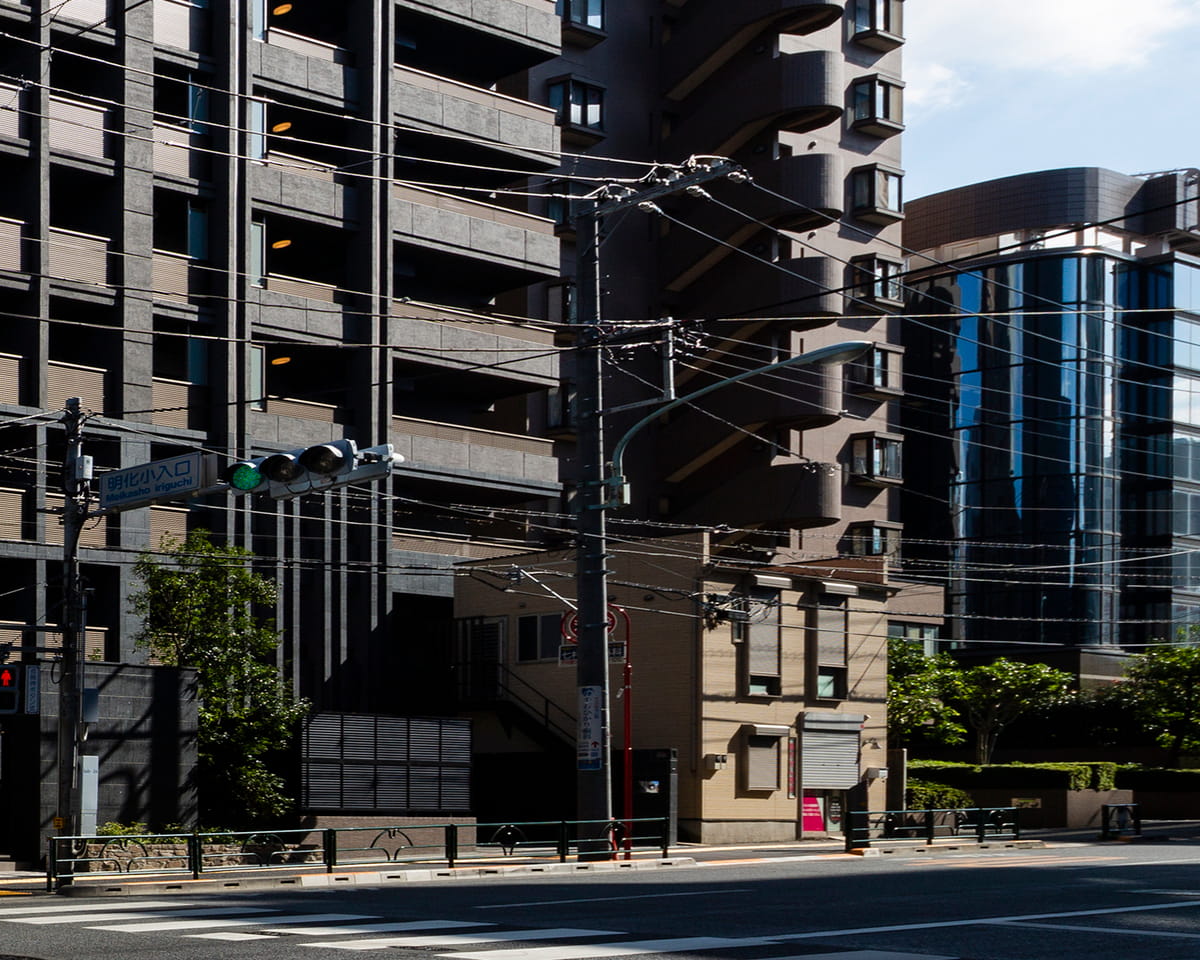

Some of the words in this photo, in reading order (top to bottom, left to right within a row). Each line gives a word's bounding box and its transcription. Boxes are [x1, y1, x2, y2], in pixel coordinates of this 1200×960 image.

[107, 460, 191, 492] 明化小入口
